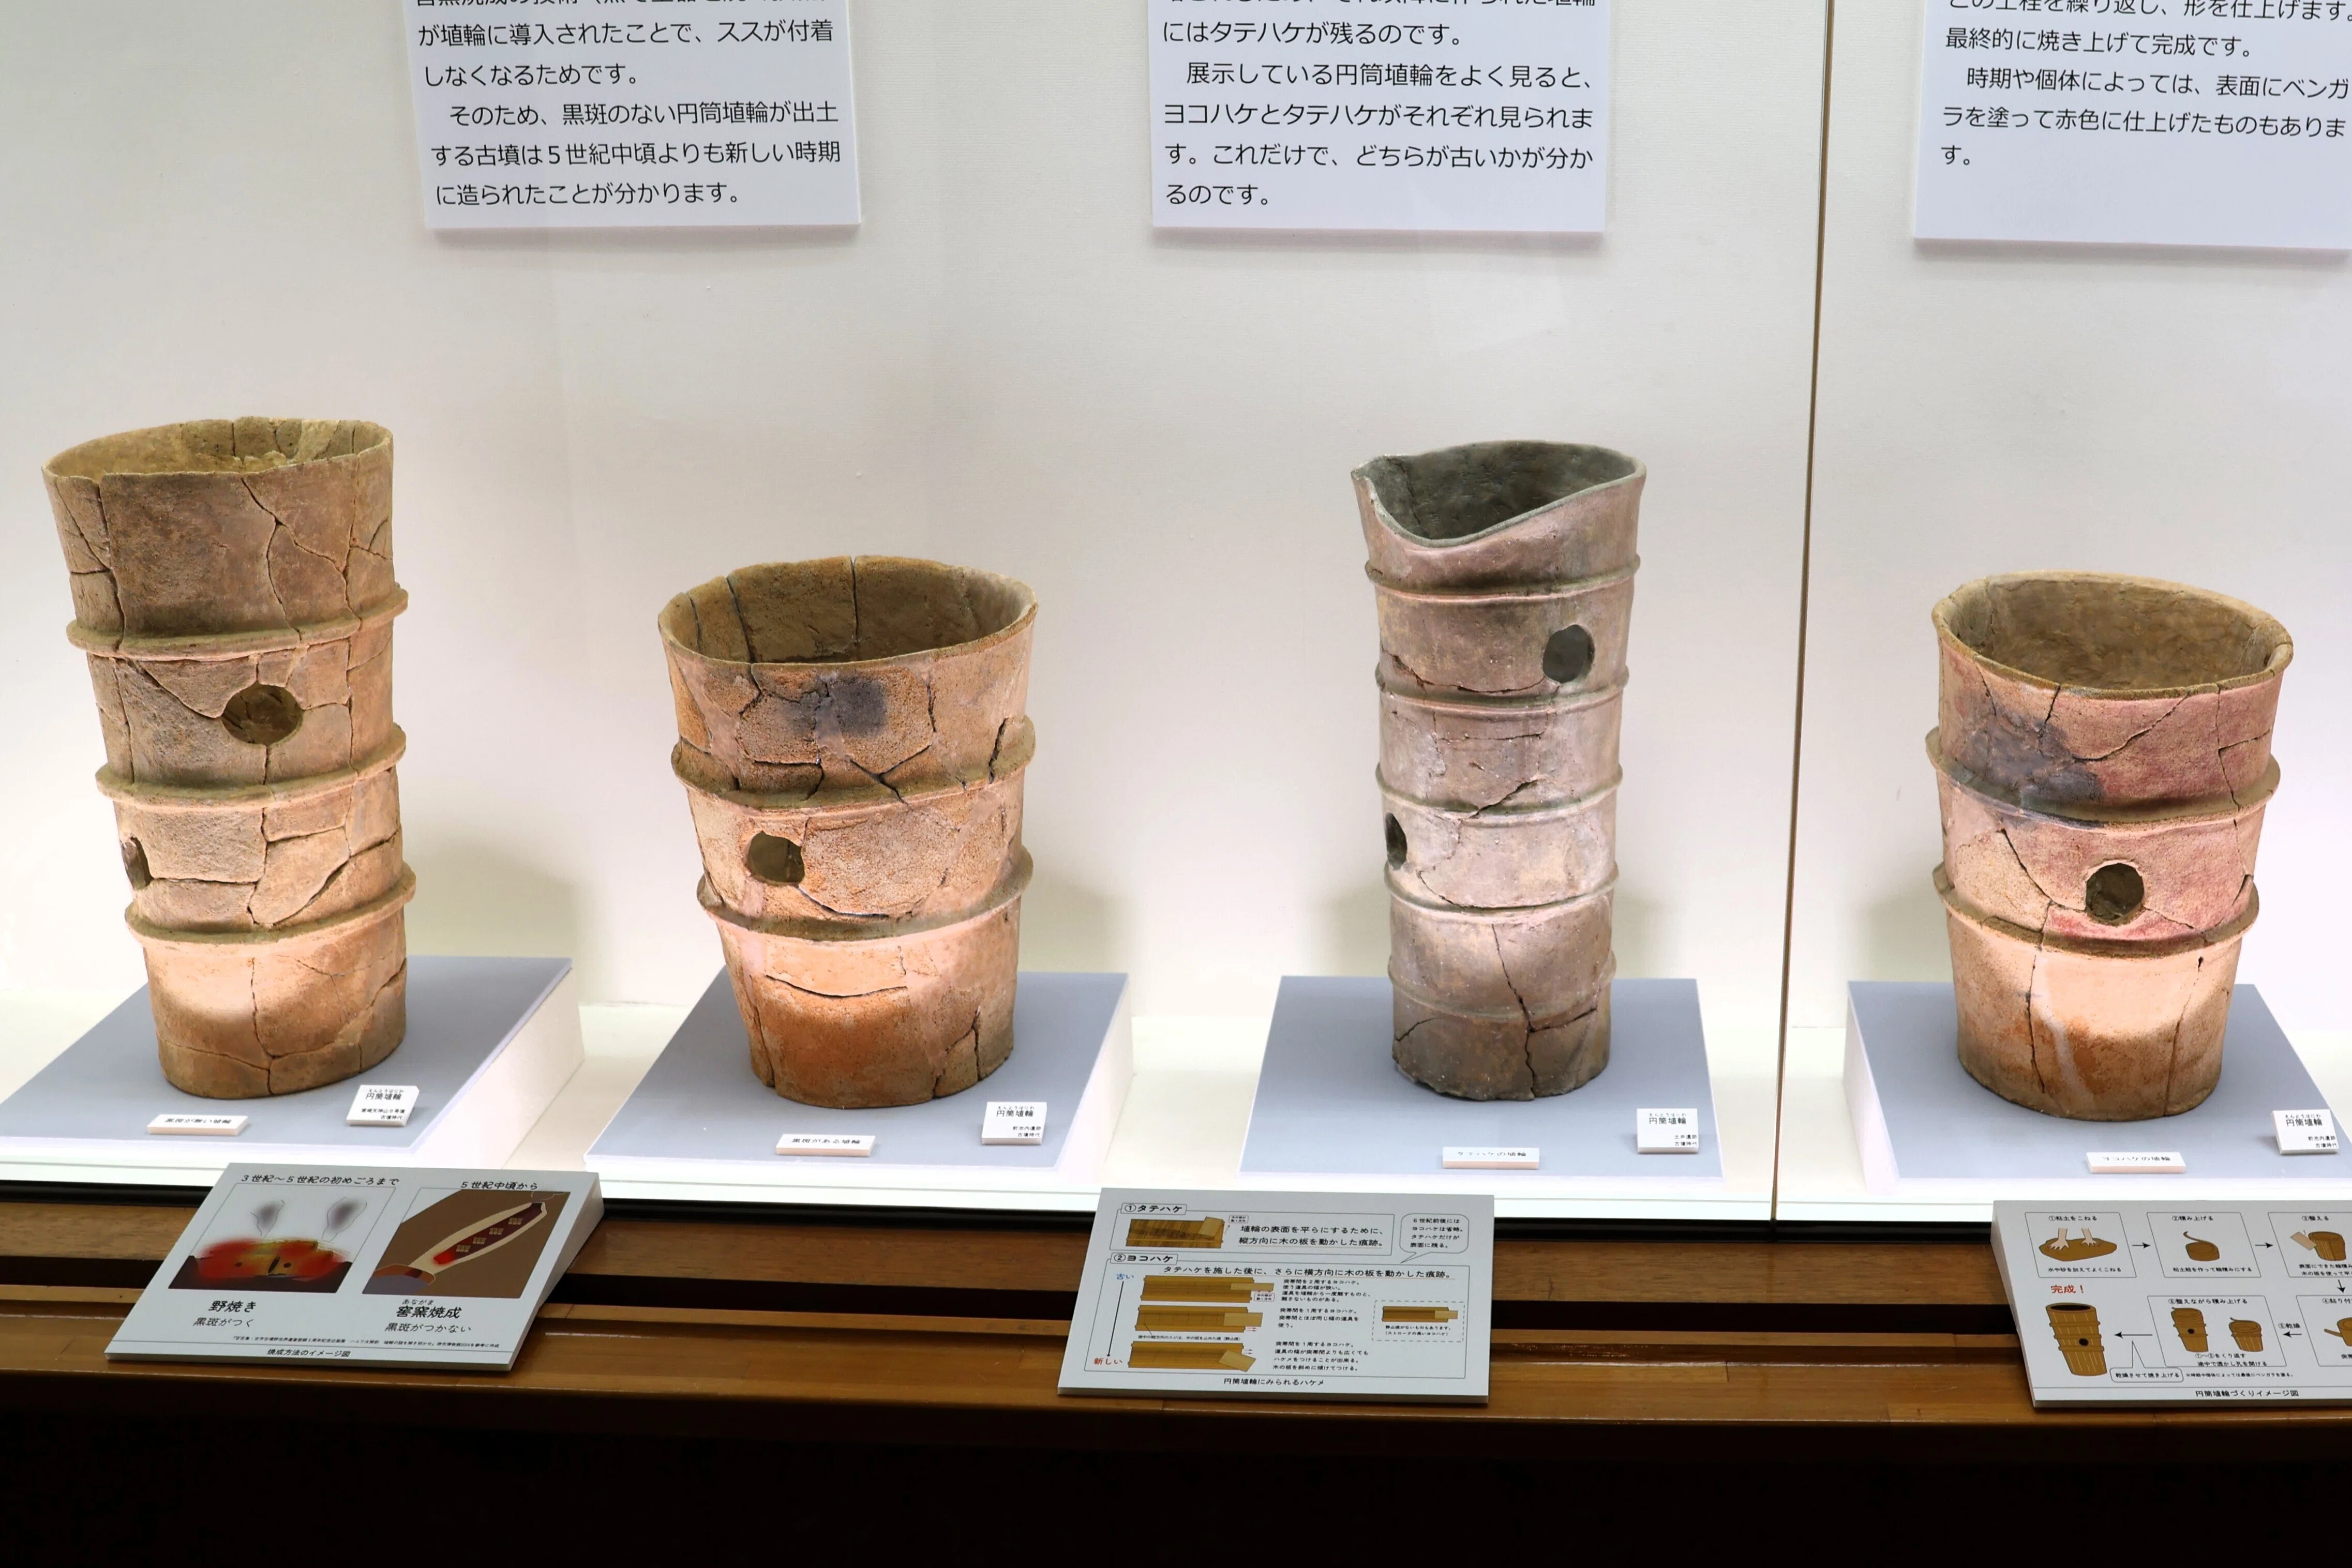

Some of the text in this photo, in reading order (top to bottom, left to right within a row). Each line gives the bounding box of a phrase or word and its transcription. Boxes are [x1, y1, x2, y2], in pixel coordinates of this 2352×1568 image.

[418, 19, 833, 46] が埴輪に導入されたことで、ススが付着
[1163, 21, 1461, 46] にはタテハケが残るのです。
[1946, 27, 2251, 58] 最終的に焼き上げて完成です。
[425, 64, 639, 86] しなくなるためです。
[1187, 63, 1592, 88] 展示している円筒埴輪をよく見ると、
[1967, 67, 2348, 100] 時期や個体によっては、表面にベンガ
[450, 101, 838, 126] そのため、黒斑のない円筒埴輪が出土
[1164, 103, 1593, 129] ヨコハケとタテハケがそれぞれ見られま
[1942, 106, 2345, 138] ラを塗って赤色に仕上げたものもありま
[431, 140, 841, 166] する古墳は5世紀中頃よりも新しい時期
[1165, 143, 1593, 170] す。これだけで、どちらが古いかが分か
[1941, 145, 1971, 167] す。
[437, 182, 739, 206] に造られたことが分かります。
[1165, 184, 1269, 206] るのです。
[2286, 1118, 2323, 1126] 円筒埴輪
[460, 1181, 537, 1189] 5世紀中頃から
[1125, 1204, 1182, 1213] ①タテハケ
[1241, 1225, 1383, 1234] 埴輪の表面を平らにするために、
[1239, 1237, 1383, 1246] 縦方向に木の板を動かした痕跡。
[1114, 1254, 1173, 1263] ②ヨコハケ
[1163, 1267, 1450, 1278] タテハケを施した後に、さらに横方向に木の板を動かした痕跡。
[2050, 1285, 2084, 1293] 完成！
[208, 1300, 256, 1313] 野焼き
[396, 1305, 462, 1318] 窖窯焼成
[193, 1317, 254, 1327] 黒斑がつく
[384, 1322, 471, 1333] 黒斑がつかない
[267, 1349, 350, 1357] 焼成方法のイメージ図
